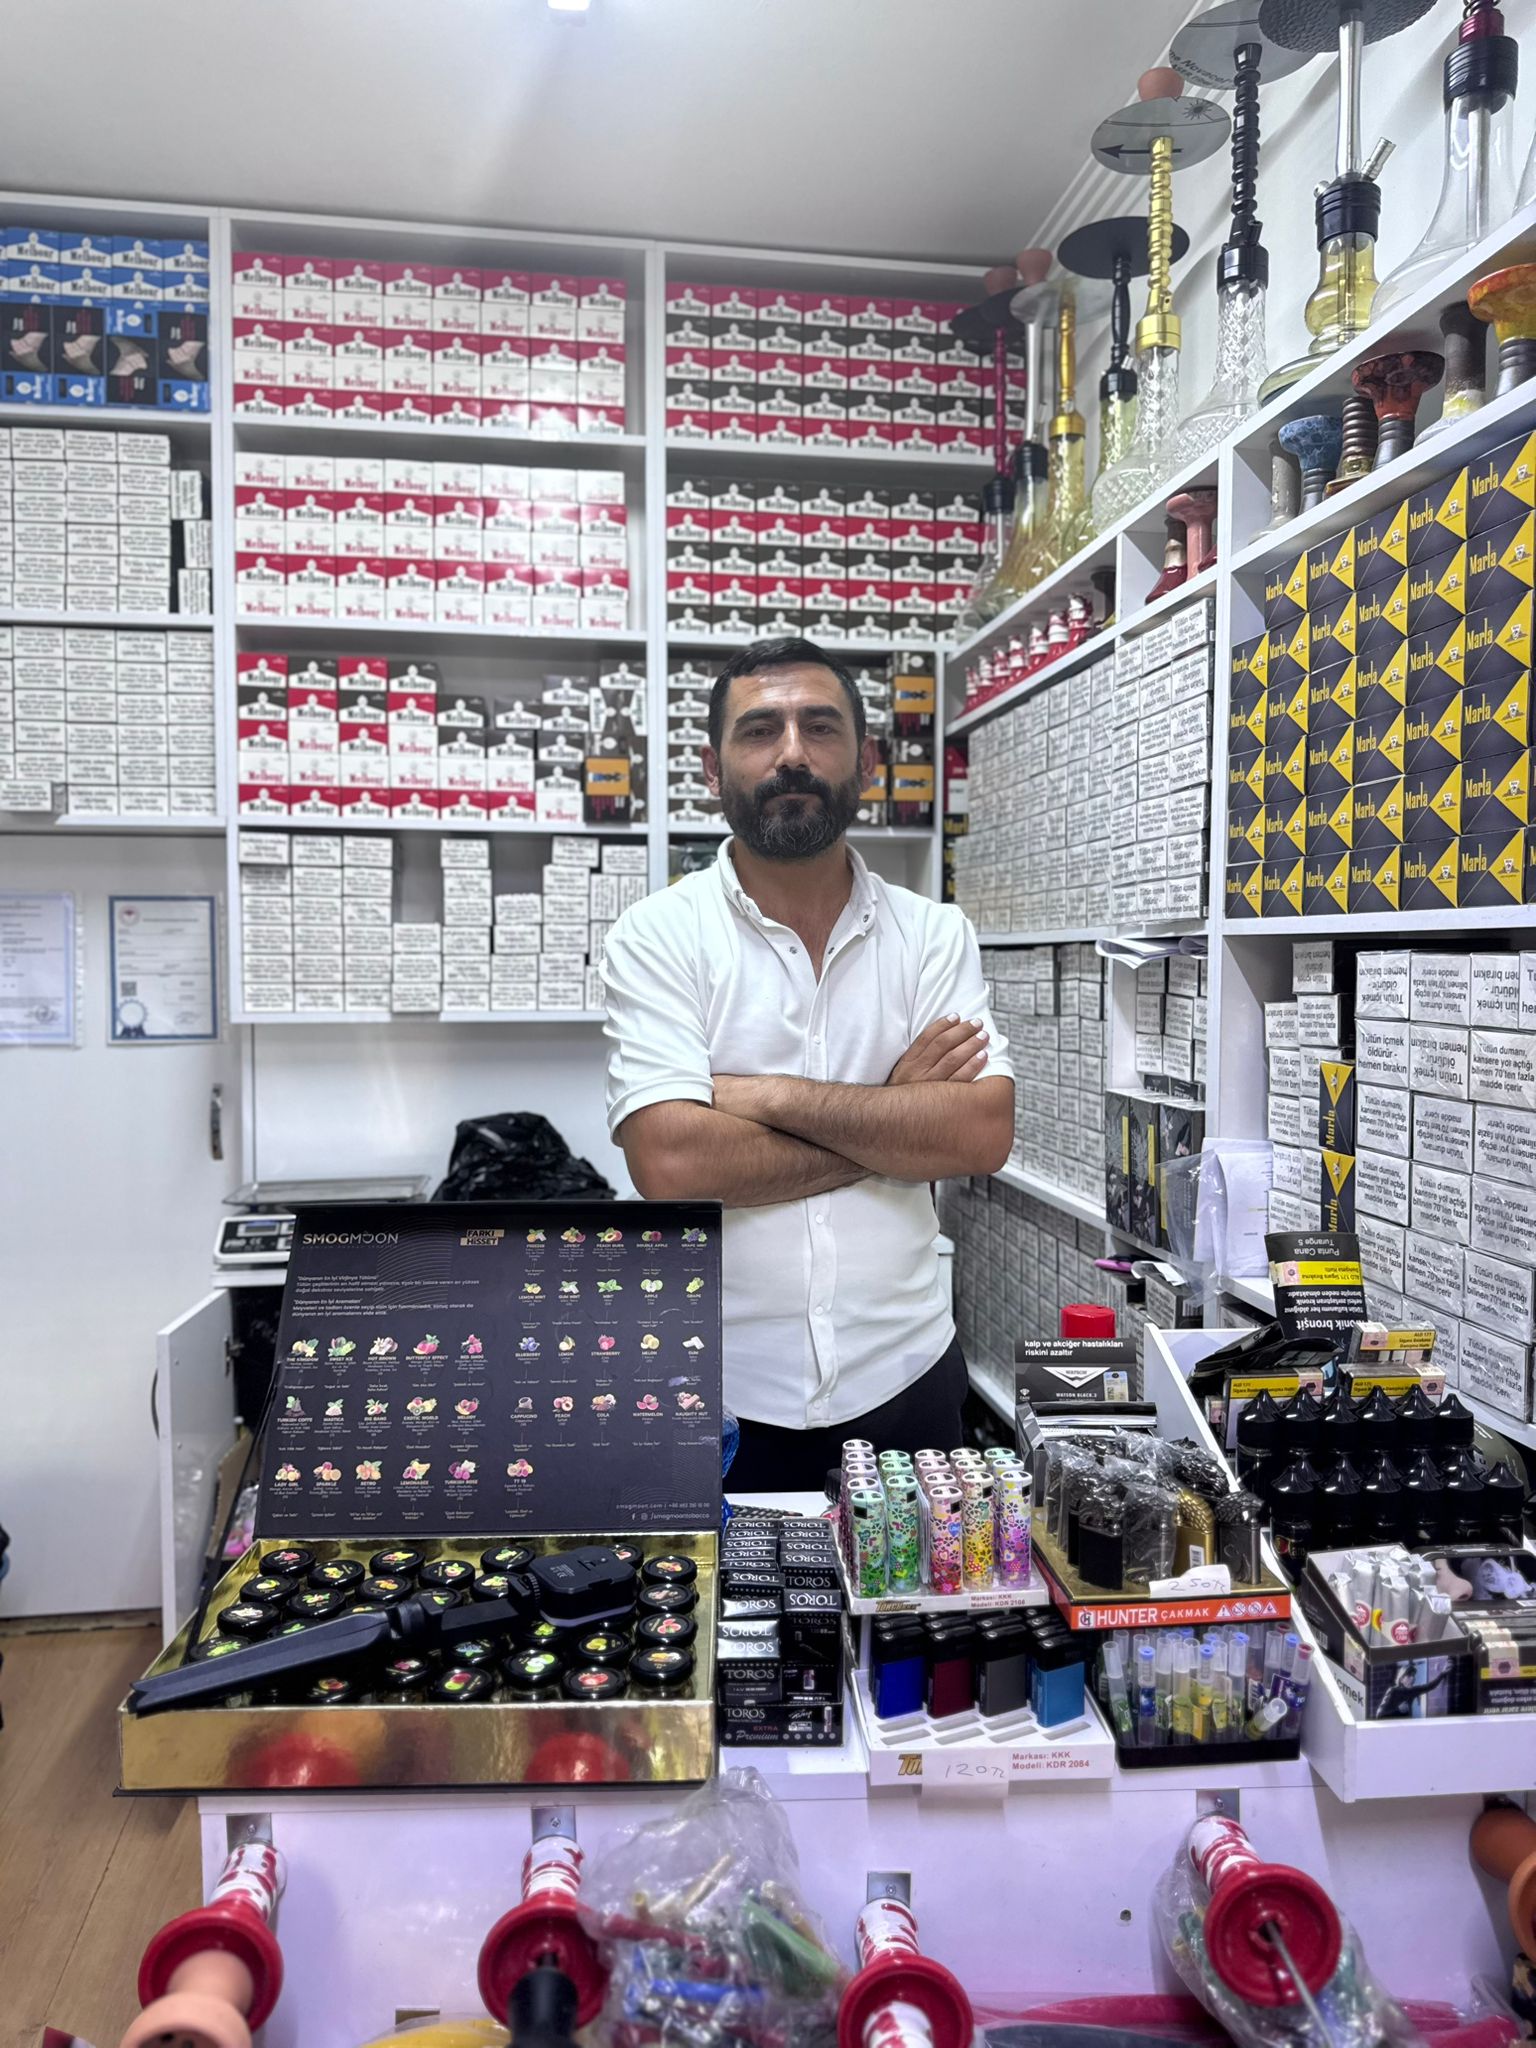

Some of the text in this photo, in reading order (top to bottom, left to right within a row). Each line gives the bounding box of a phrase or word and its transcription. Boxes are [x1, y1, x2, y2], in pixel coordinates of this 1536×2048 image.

[1472, 462, 1499, 498] Marla
[1409, 498, 1433, 533] Marla
[1357, 527, 1378, 557] Marla
[1310, 552, 1329, 580] Marla
[1470, 541, 1497, 576] Marla
[1410, 569, 1433, 601] Marla
[1359, 594, 1380, 623] Marla
[1467, 617, 1493, 652] Marla
[1410, 641, 1434, 671] Marla
[1464, 693, 1491, 727] Marla
[1406, 712, 1430, 743] Marla
[1405, 782, 1428, 810] Marla
[1465, 768, 1491, 799] Marla
[1404, 852, 1427, 879] Marla
[1461, 843, 1487, 874] Marla
[1358, 1061, 1407, 1074] hemen bırakın
[1323, 1110, 1335, 1146] Marla
[303, 1231, 399, 1244] SMOGMOON
[1294, 1248, 1340, 1256] Punta Cana
[1296, 1318, 1333, 1330] bronşit
[1025, 1340, 1040, 1348] kalp
[1053, 1340, 1080, 1348] akciğer
[785, 1555, 831, 1563] TOROS
[787, 1543, 831, 1551] TOROS
[733, 1573, 779, 1582] TOROS
[786, 1576, 831, 1588] TOROS
[789, 1593, 837, 1606] TOROS
[1097, 1608, 1209, 1626] HUNTER ÇAKMAK
[723, 1669, 775, 1680] TOROS
[724, 1708, 765, 1719] TOROS
